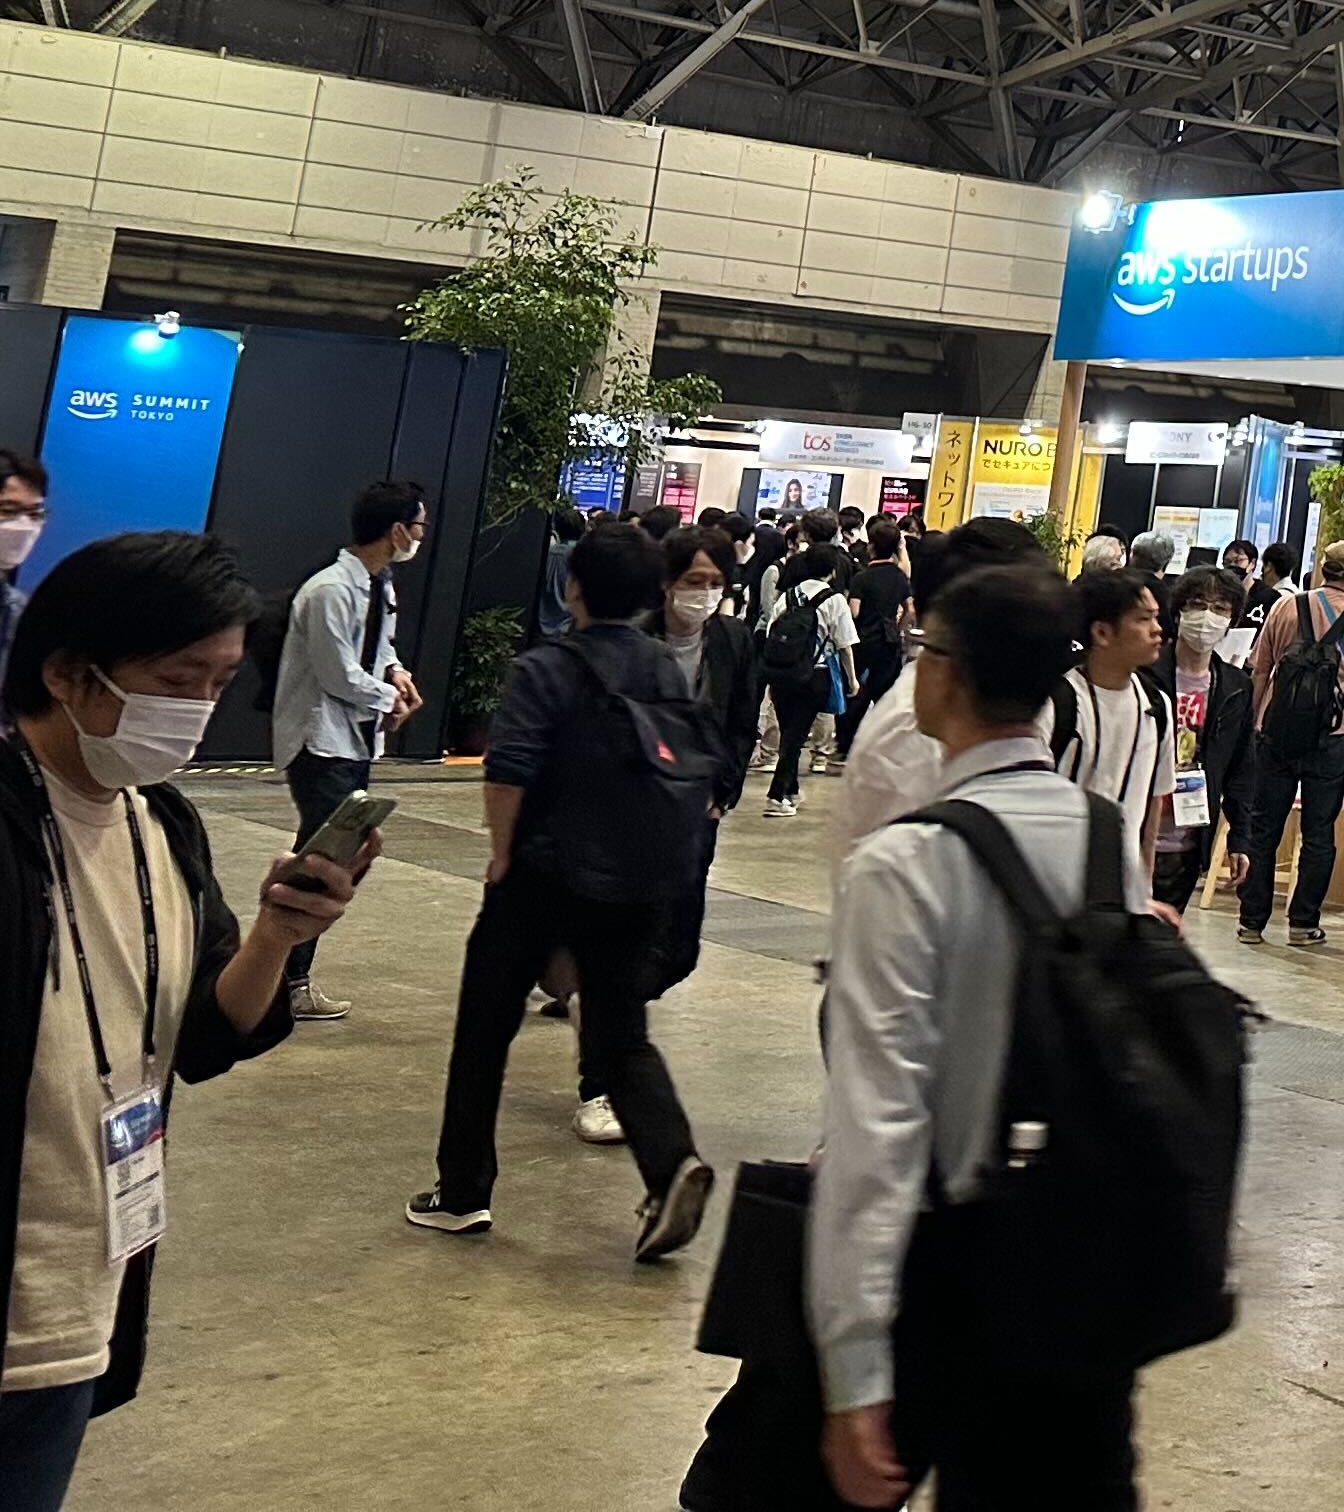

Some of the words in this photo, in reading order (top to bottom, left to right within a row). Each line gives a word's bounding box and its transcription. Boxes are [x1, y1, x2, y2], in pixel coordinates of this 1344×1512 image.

[1116, 248, 1177, 286] aws
[1181, 245, 1311, 292] startups
[69, 389, 119, 409] aws
[131, 394, 212, 411] SUMMIT
[130, 409, 175, 421] TOKYO
[803, 430, 832, 451] tcs
[983, 439, 1043, 457] NURO
